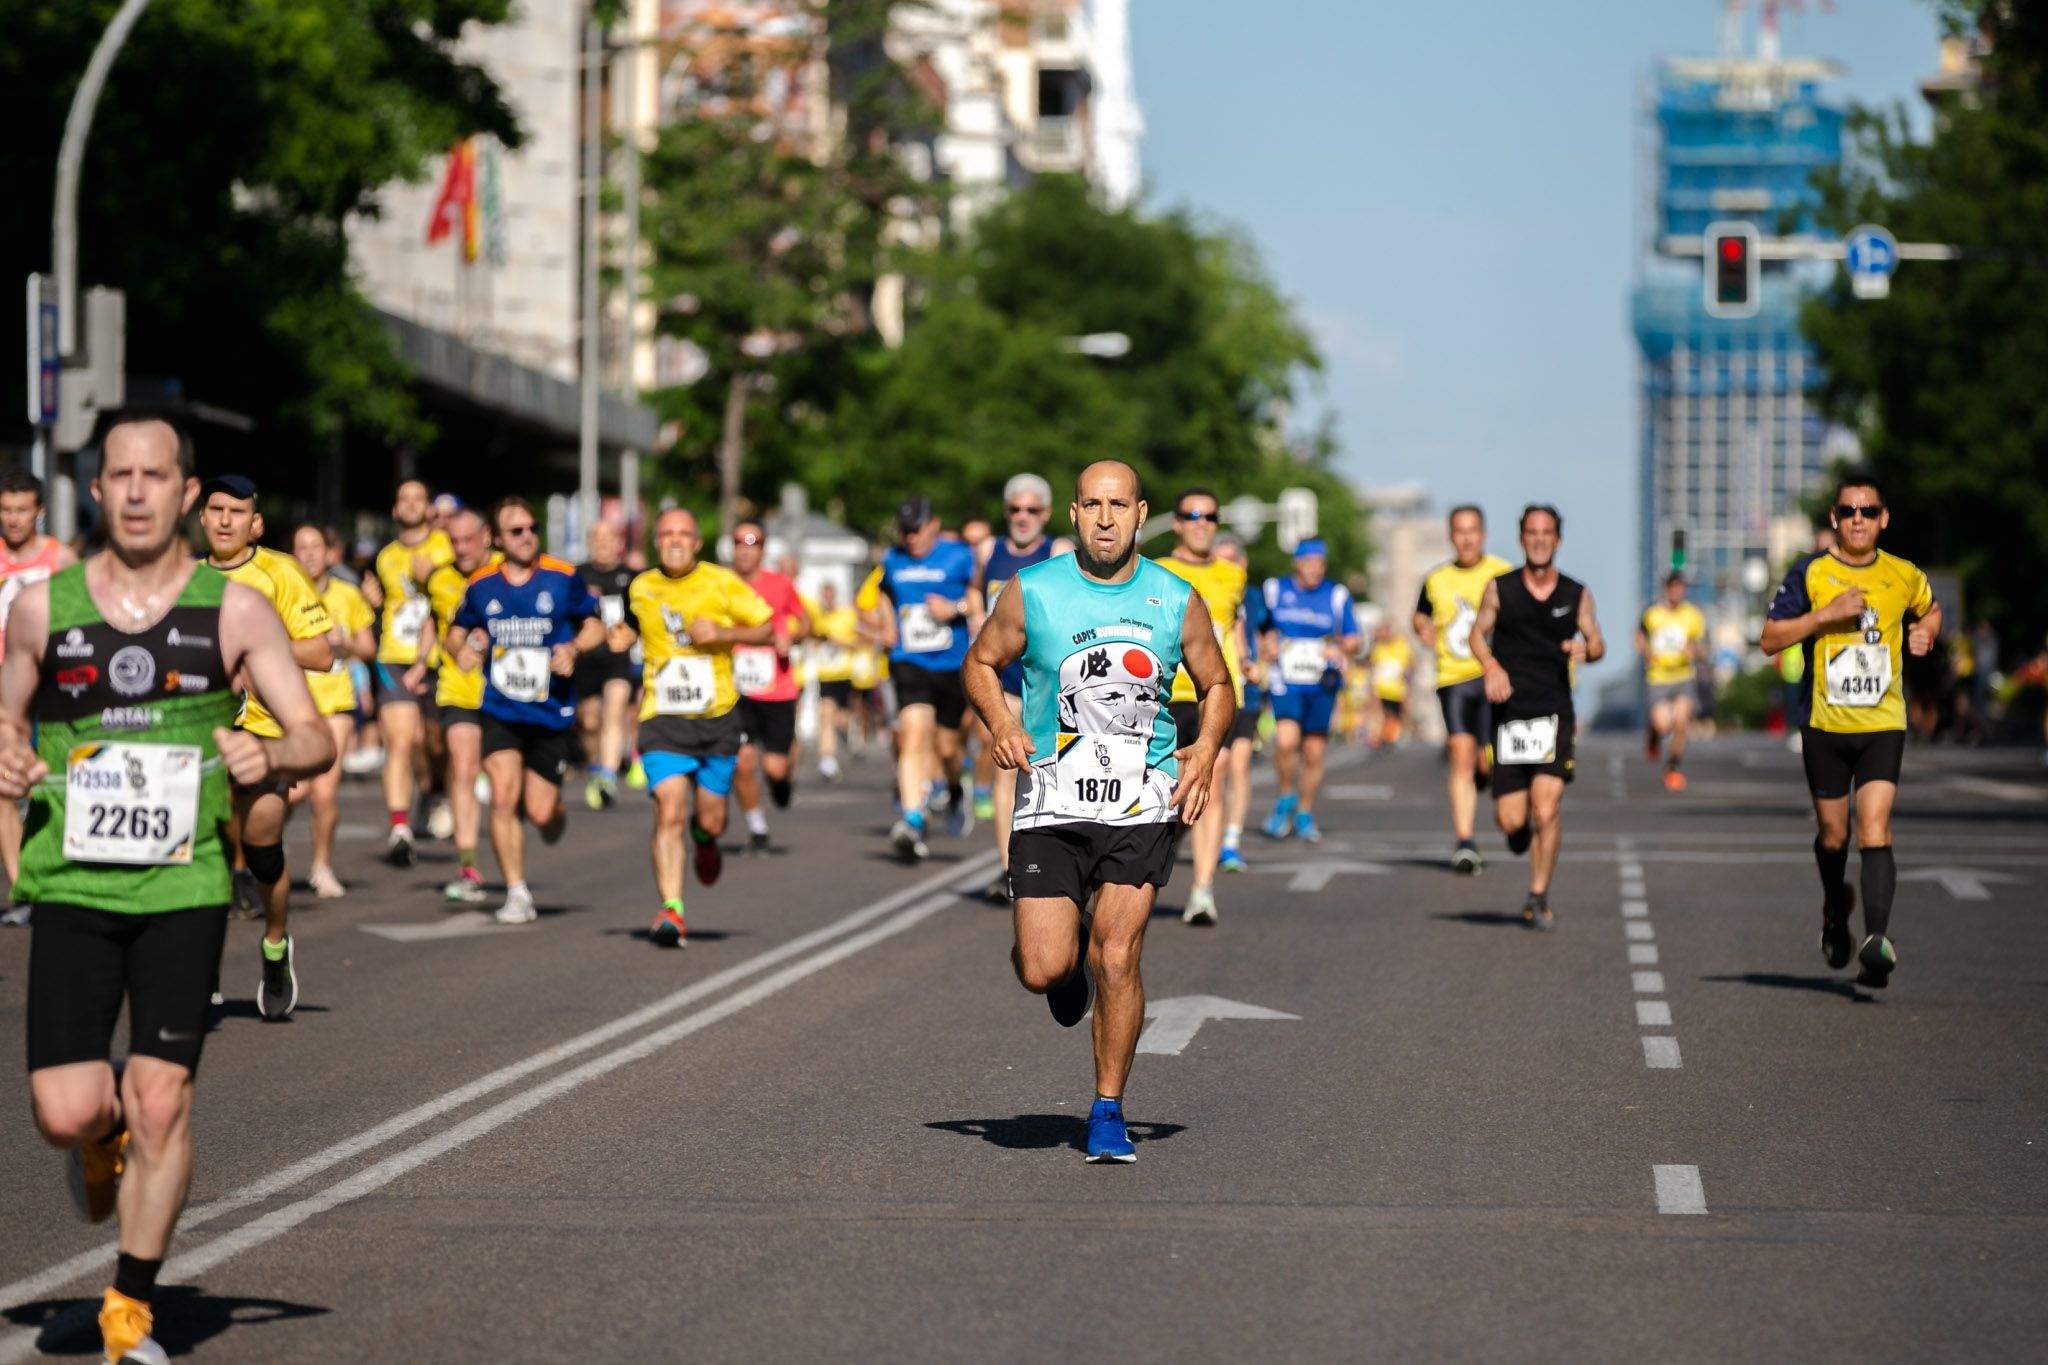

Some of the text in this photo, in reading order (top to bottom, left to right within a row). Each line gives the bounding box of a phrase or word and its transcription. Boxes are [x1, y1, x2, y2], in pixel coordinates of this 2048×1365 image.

[1072, 628, 1097, 645] CAPI'S
[1841, 675, 1881, 694] 4341
[1075, 777, 1122, 802] 1870
[88, 803, 171, 841] 2263
